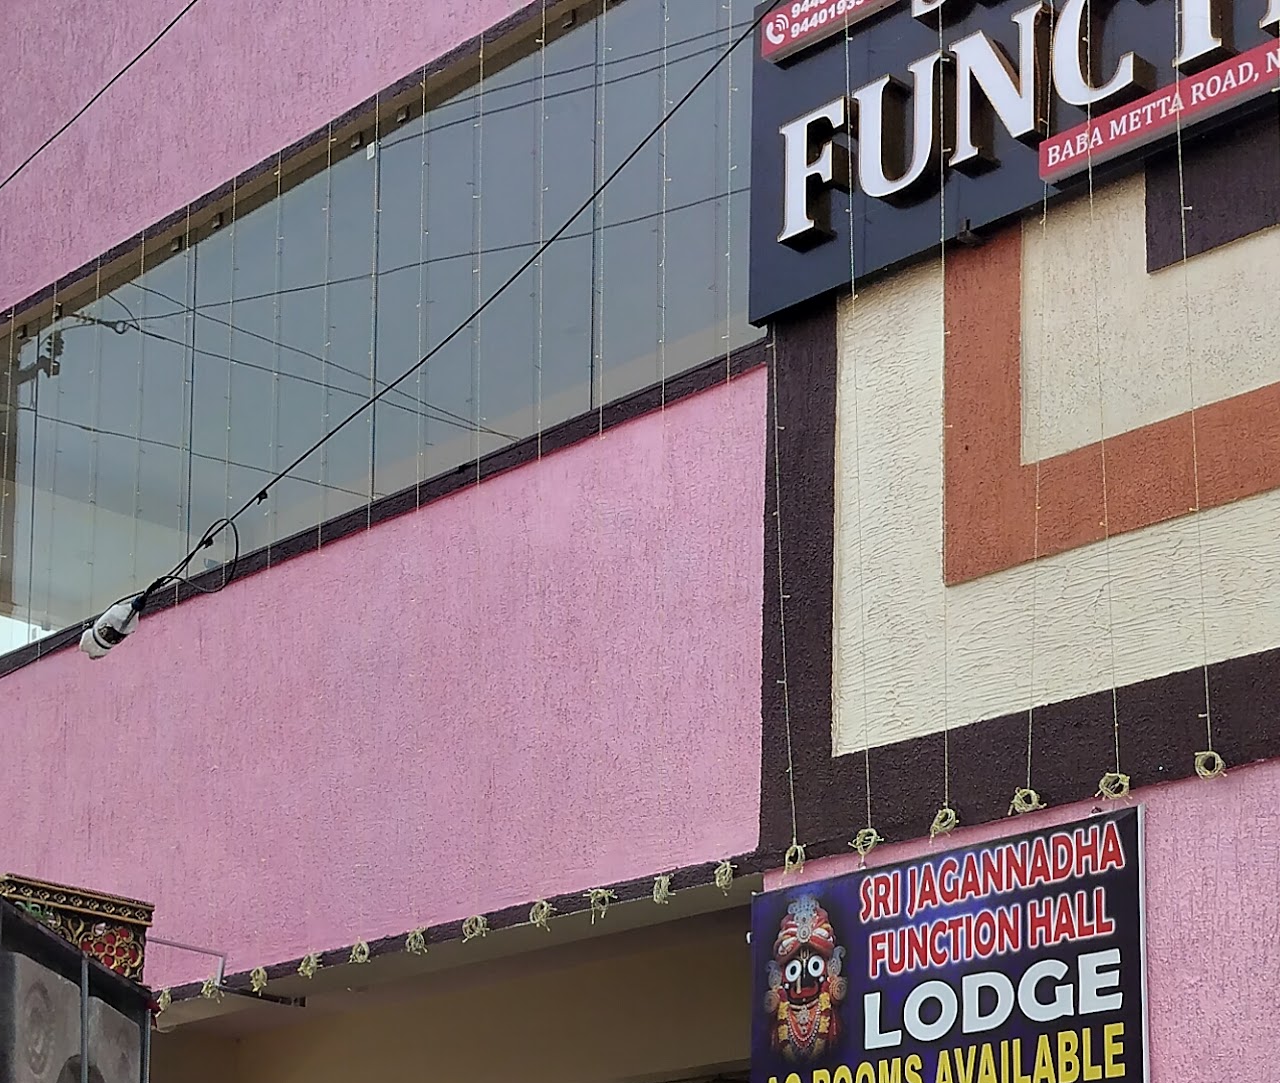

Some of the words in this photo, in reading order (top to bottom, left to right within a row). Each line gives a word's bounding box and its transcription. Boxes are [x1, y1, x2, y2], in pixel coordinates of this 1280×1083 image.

[1046, 129, 1104, 168] BABA
[1109, 91, 1184, 141] METTA
[1191, 61, 1259, 103] ROAD,
[859, 871, 901, 924] SRI
[906, 820, 1126, 917] JAGANNADHA
[869, 909, 1021, 979] FUNCTION
[1029, 888, 1115, 948] HALL
[863, 949, 1123, 1050] LODGE
